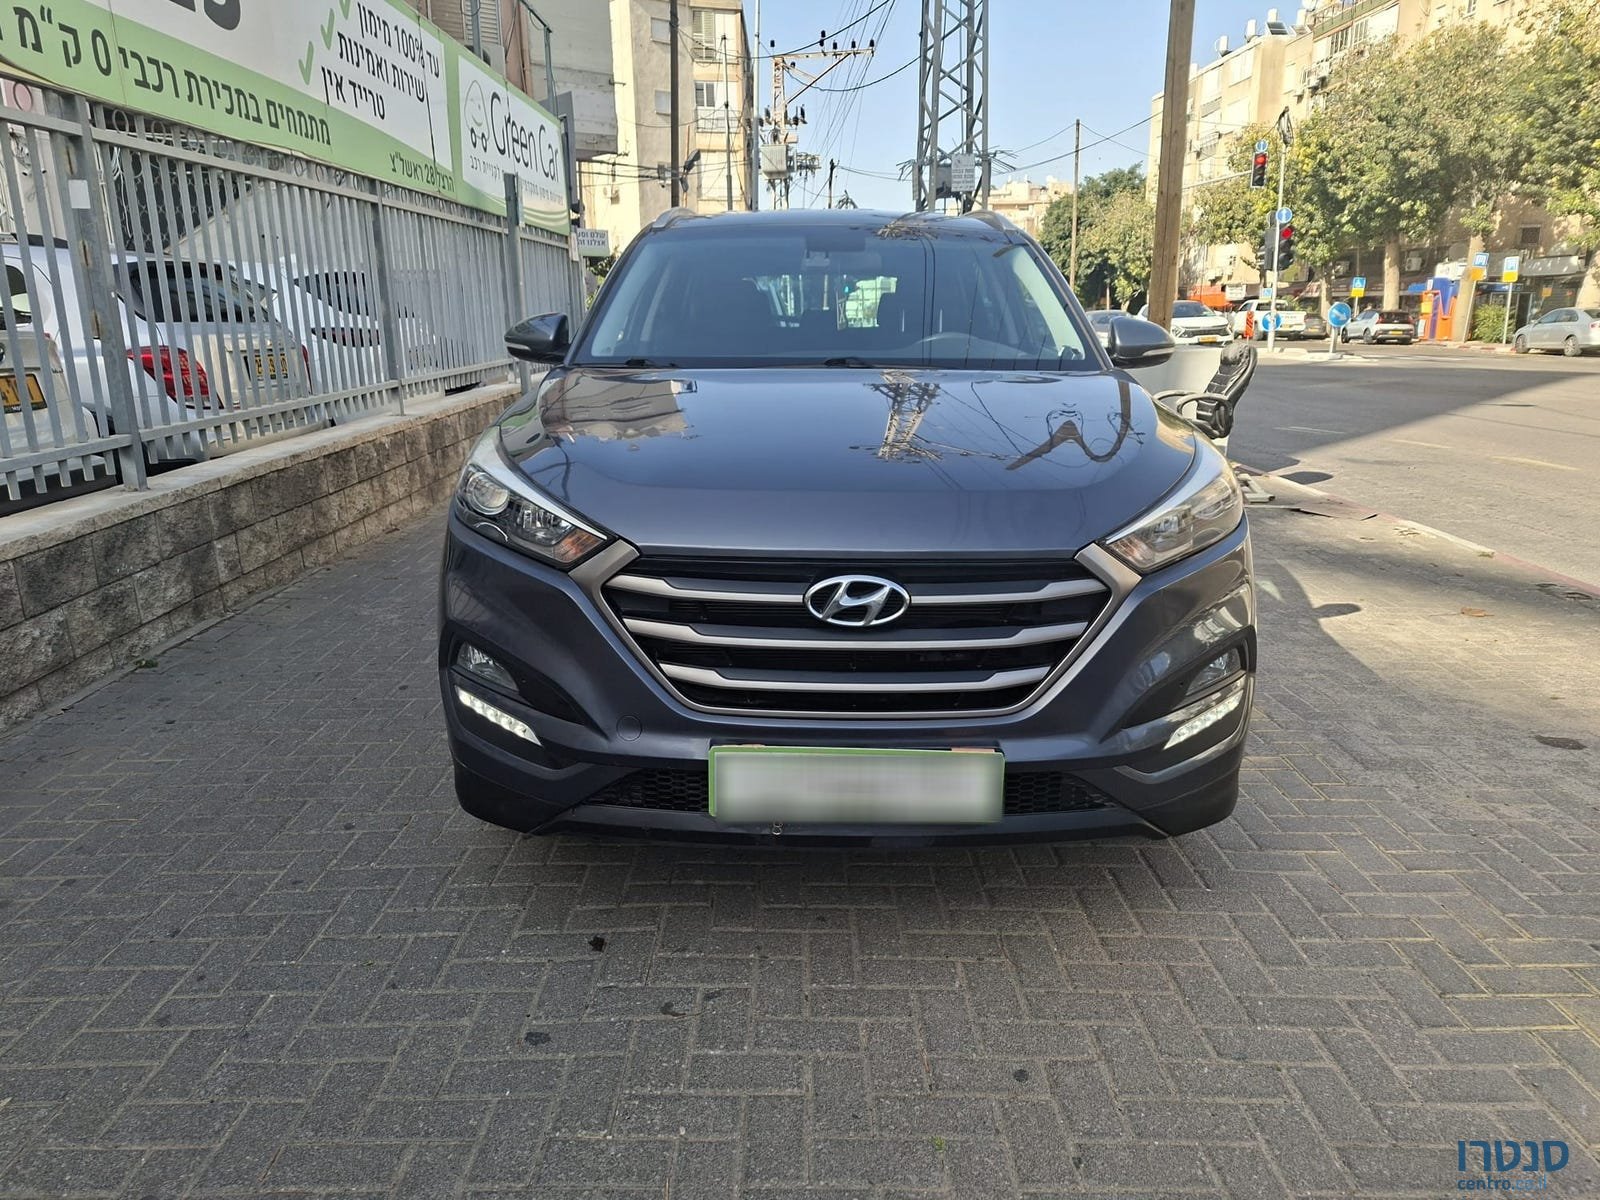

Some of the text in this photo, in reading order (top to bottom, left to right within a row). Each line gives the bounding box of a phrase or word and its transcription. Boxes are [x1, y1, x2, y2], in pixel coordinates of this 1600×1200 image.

[337, 32, 425, 102] שירות ואמינות
[357, 2, 440, 78] עד 100% מימון
[118, 46, 180, 98] רכבי
[184, 69, 262, 125] במכירת
[321, 65, 386, 120] טרייד אין
[266, 98, 331, 146] מתמחים
[490, 92, 559, 183] Green Car
[424, 163, 436, 186] 28
[435, 168, 455, 192] הרצל
